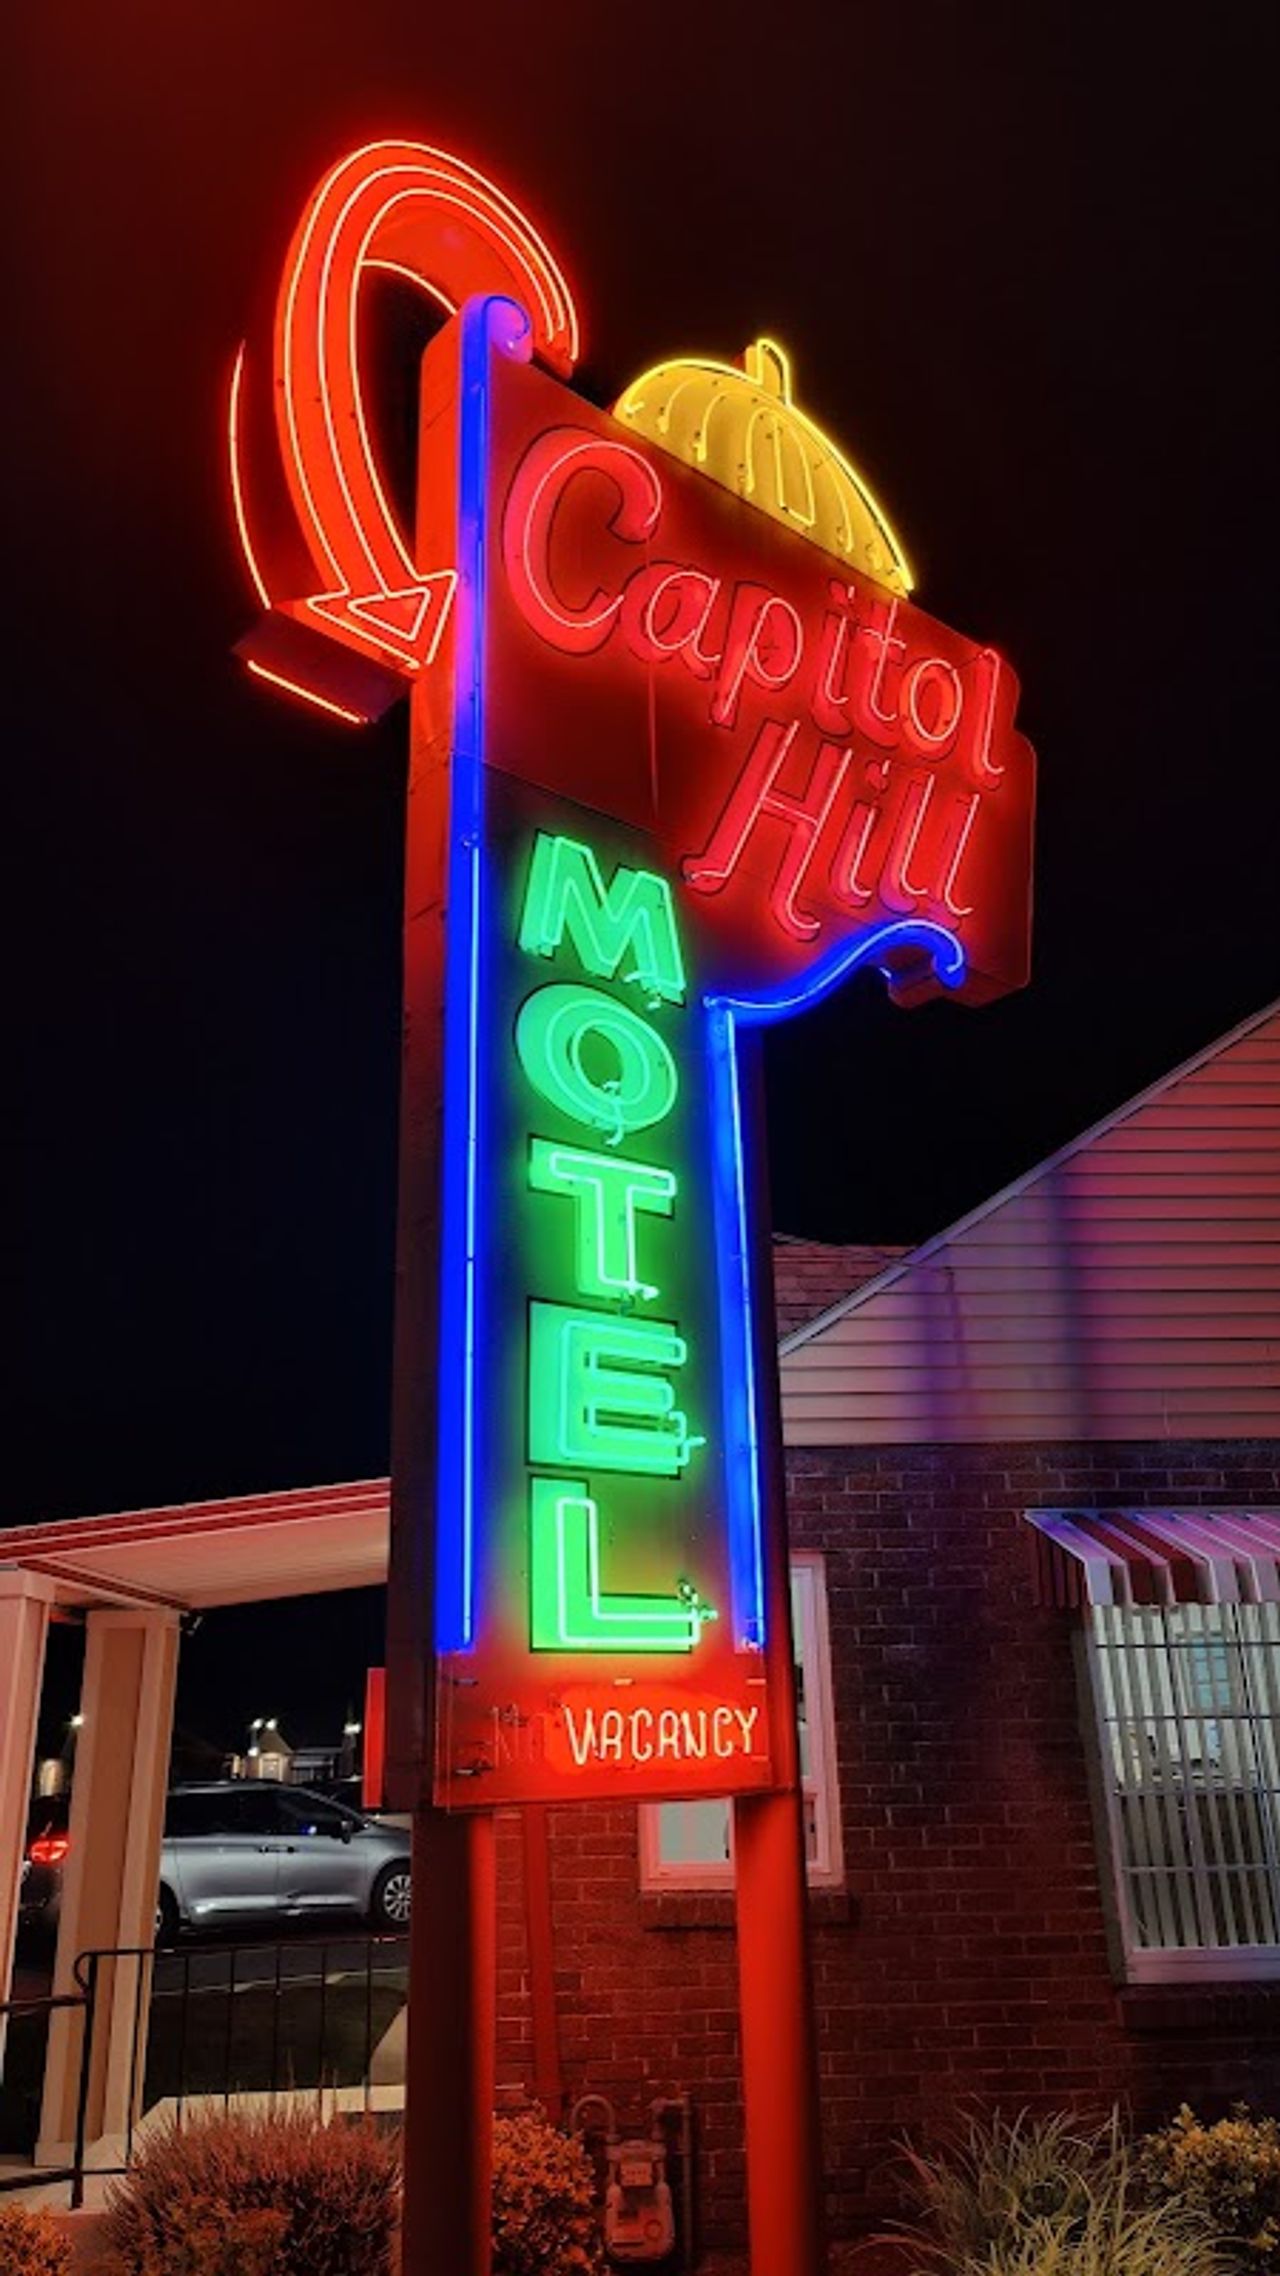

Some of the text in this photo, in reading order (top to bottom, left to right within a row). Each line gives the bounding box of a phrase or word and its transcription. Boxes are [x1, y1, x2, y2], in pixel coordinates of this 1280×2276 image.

[503, 425, 1005, 790] Capitol
[680, 719, 980, 941] Hill
[515, 829, 708, 1654] MOTEL
[562, 1705, 759, 1766] VACANCY
